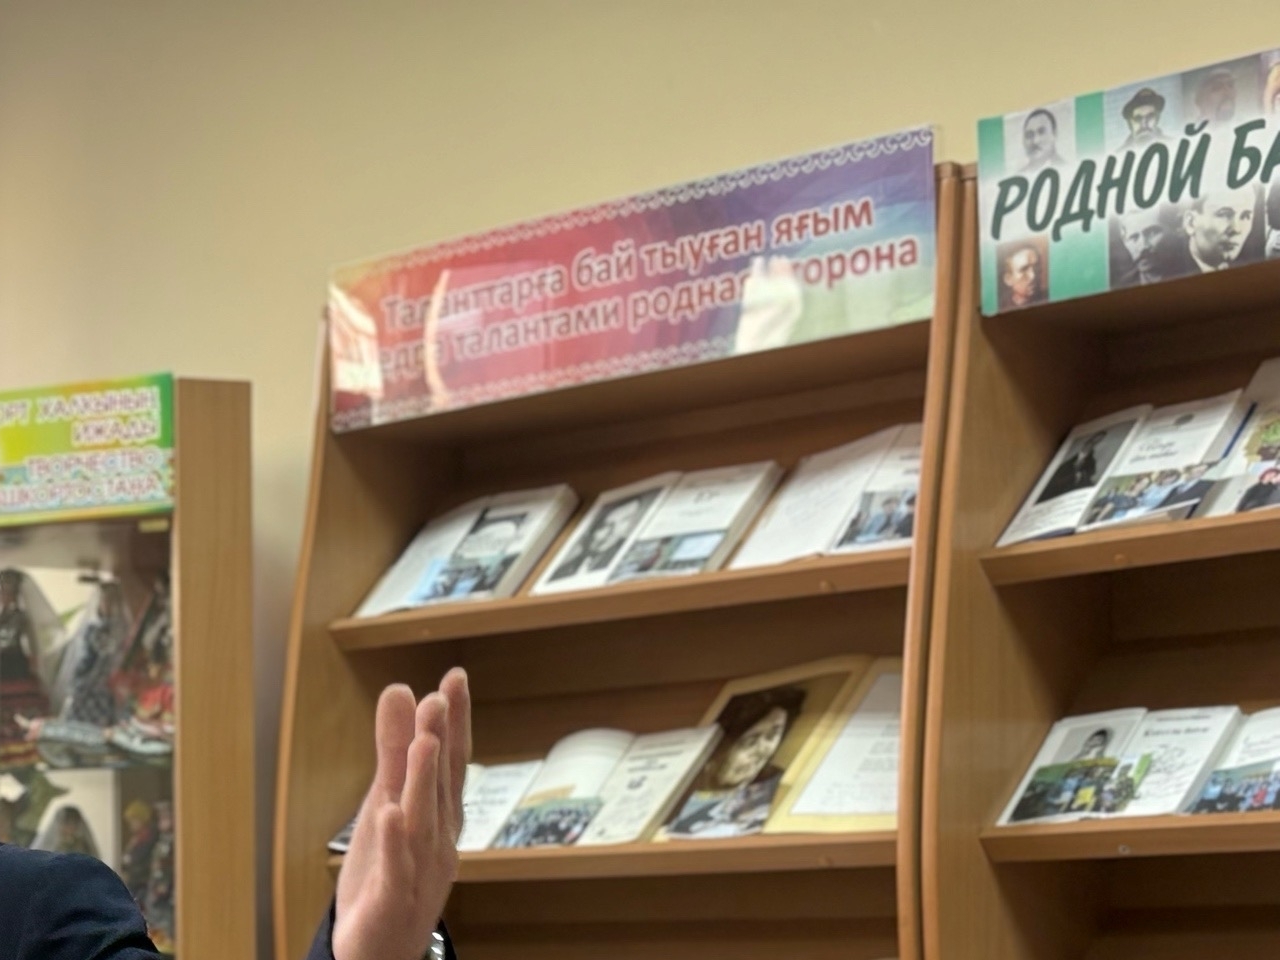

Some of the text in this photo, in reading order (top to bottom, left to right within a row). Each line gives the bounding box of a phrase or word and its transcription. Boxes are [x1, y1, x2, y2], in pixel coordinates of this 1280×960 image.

[991, 119, 1211, 242] РОДНОЙ
[573, 241, 634, 293] бай
[643, 221, 764, 276] тыуған
[773, 199, 876, 246] яғым
[454, 303, 623, 357] талантами
